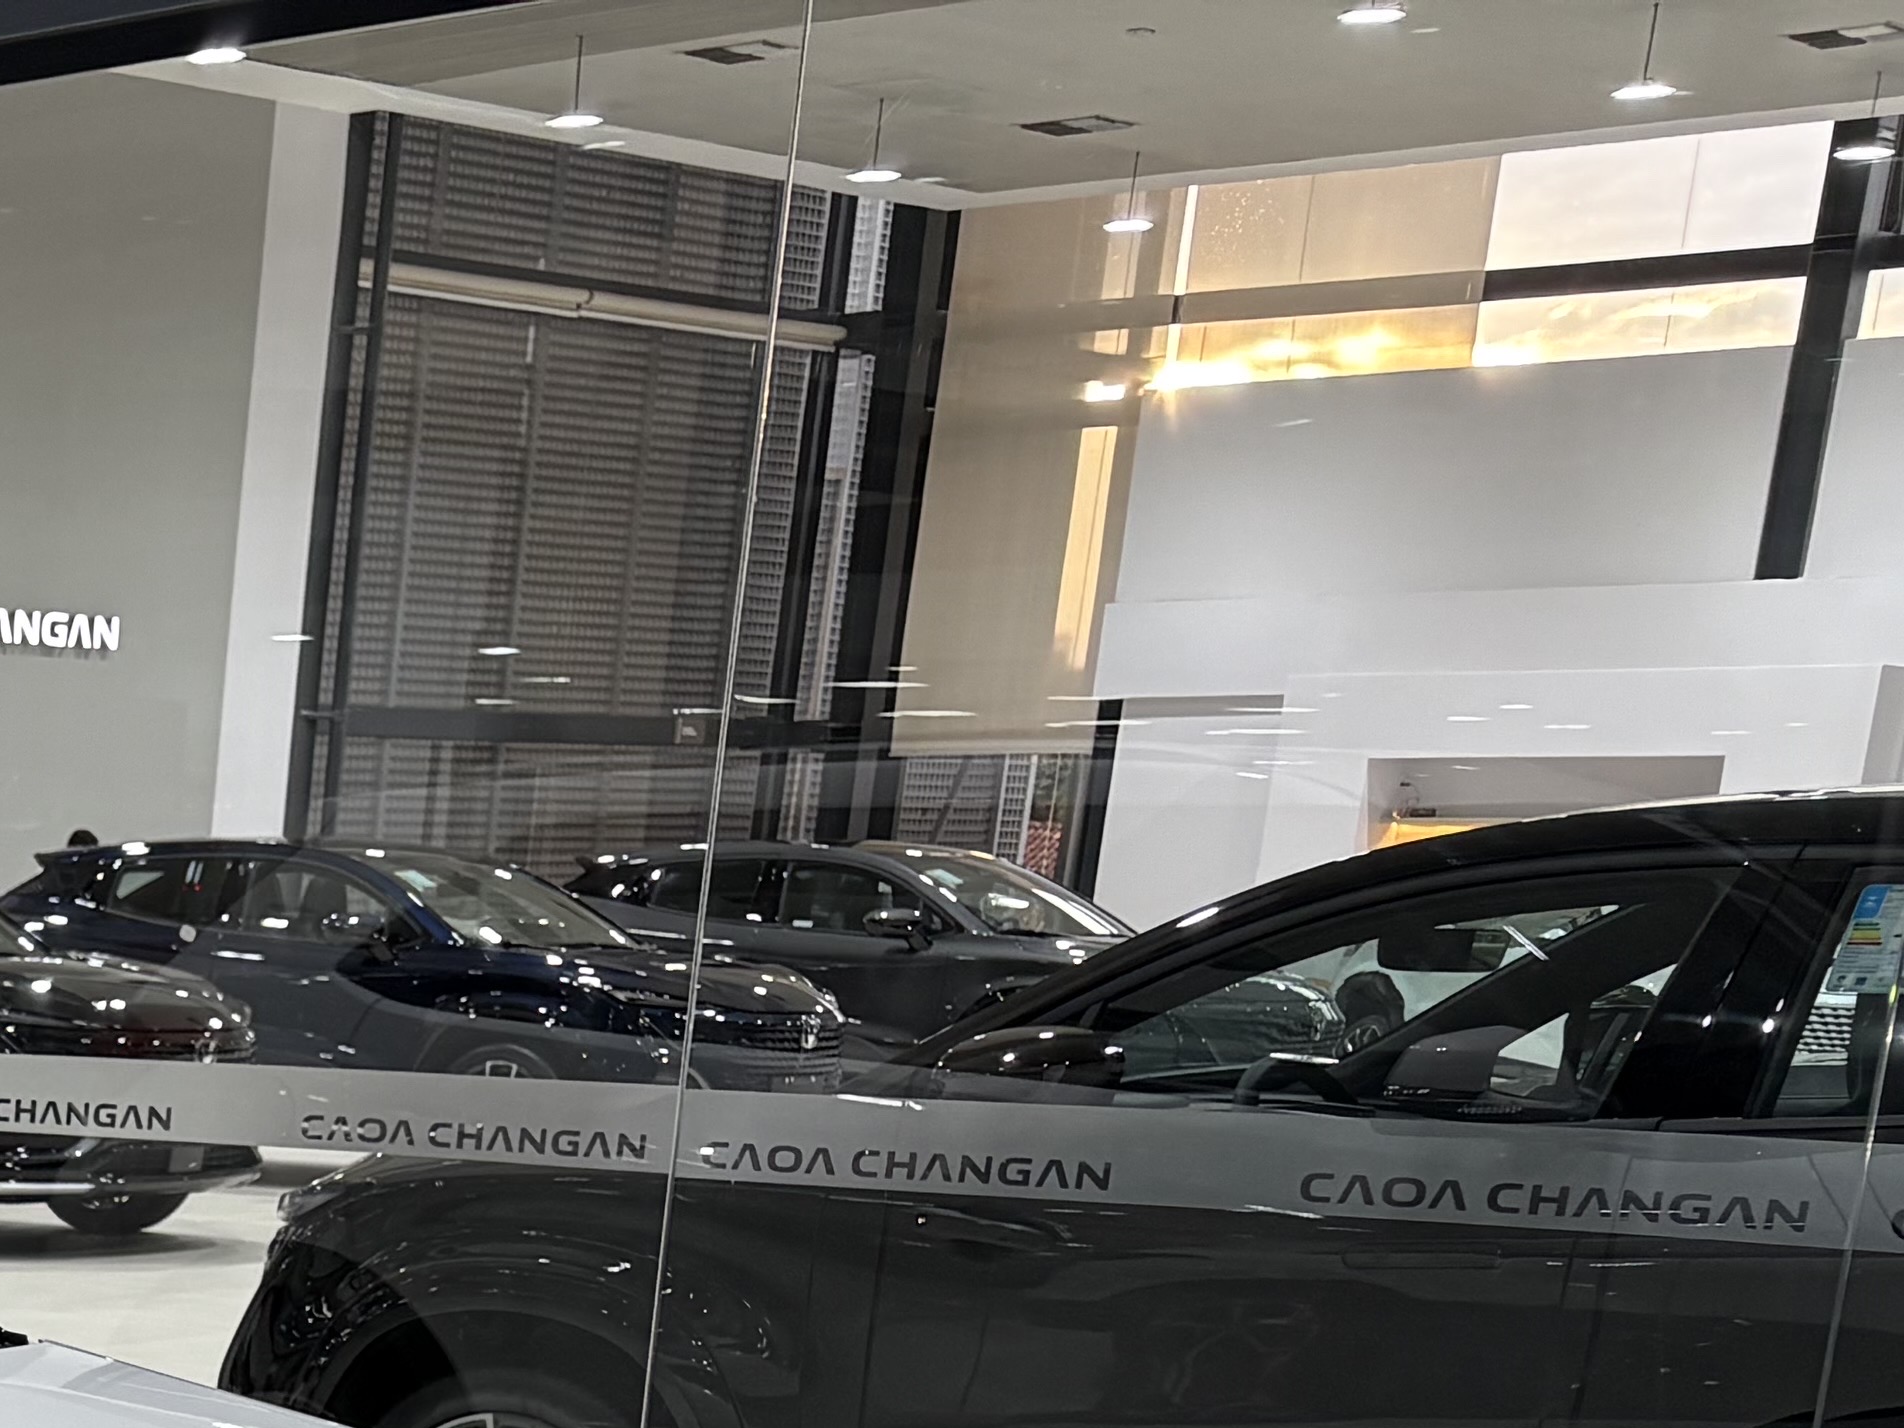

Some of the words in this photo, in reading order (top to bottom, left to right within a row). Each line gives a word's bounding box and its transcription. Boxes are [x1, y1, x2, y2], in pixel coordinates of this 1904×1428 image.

[300, 1114, 415, 1147] CAOA
[427, 1121, 647, 1160] CHANGAN
[699, 1141, 836, 1176] CAOA
[850, 1149, 1112, 1191] CHANGAN
[1299, 1172, 1467, 1213] CAOA
[1486, 1182, 1810, 1233] CHANGAN
